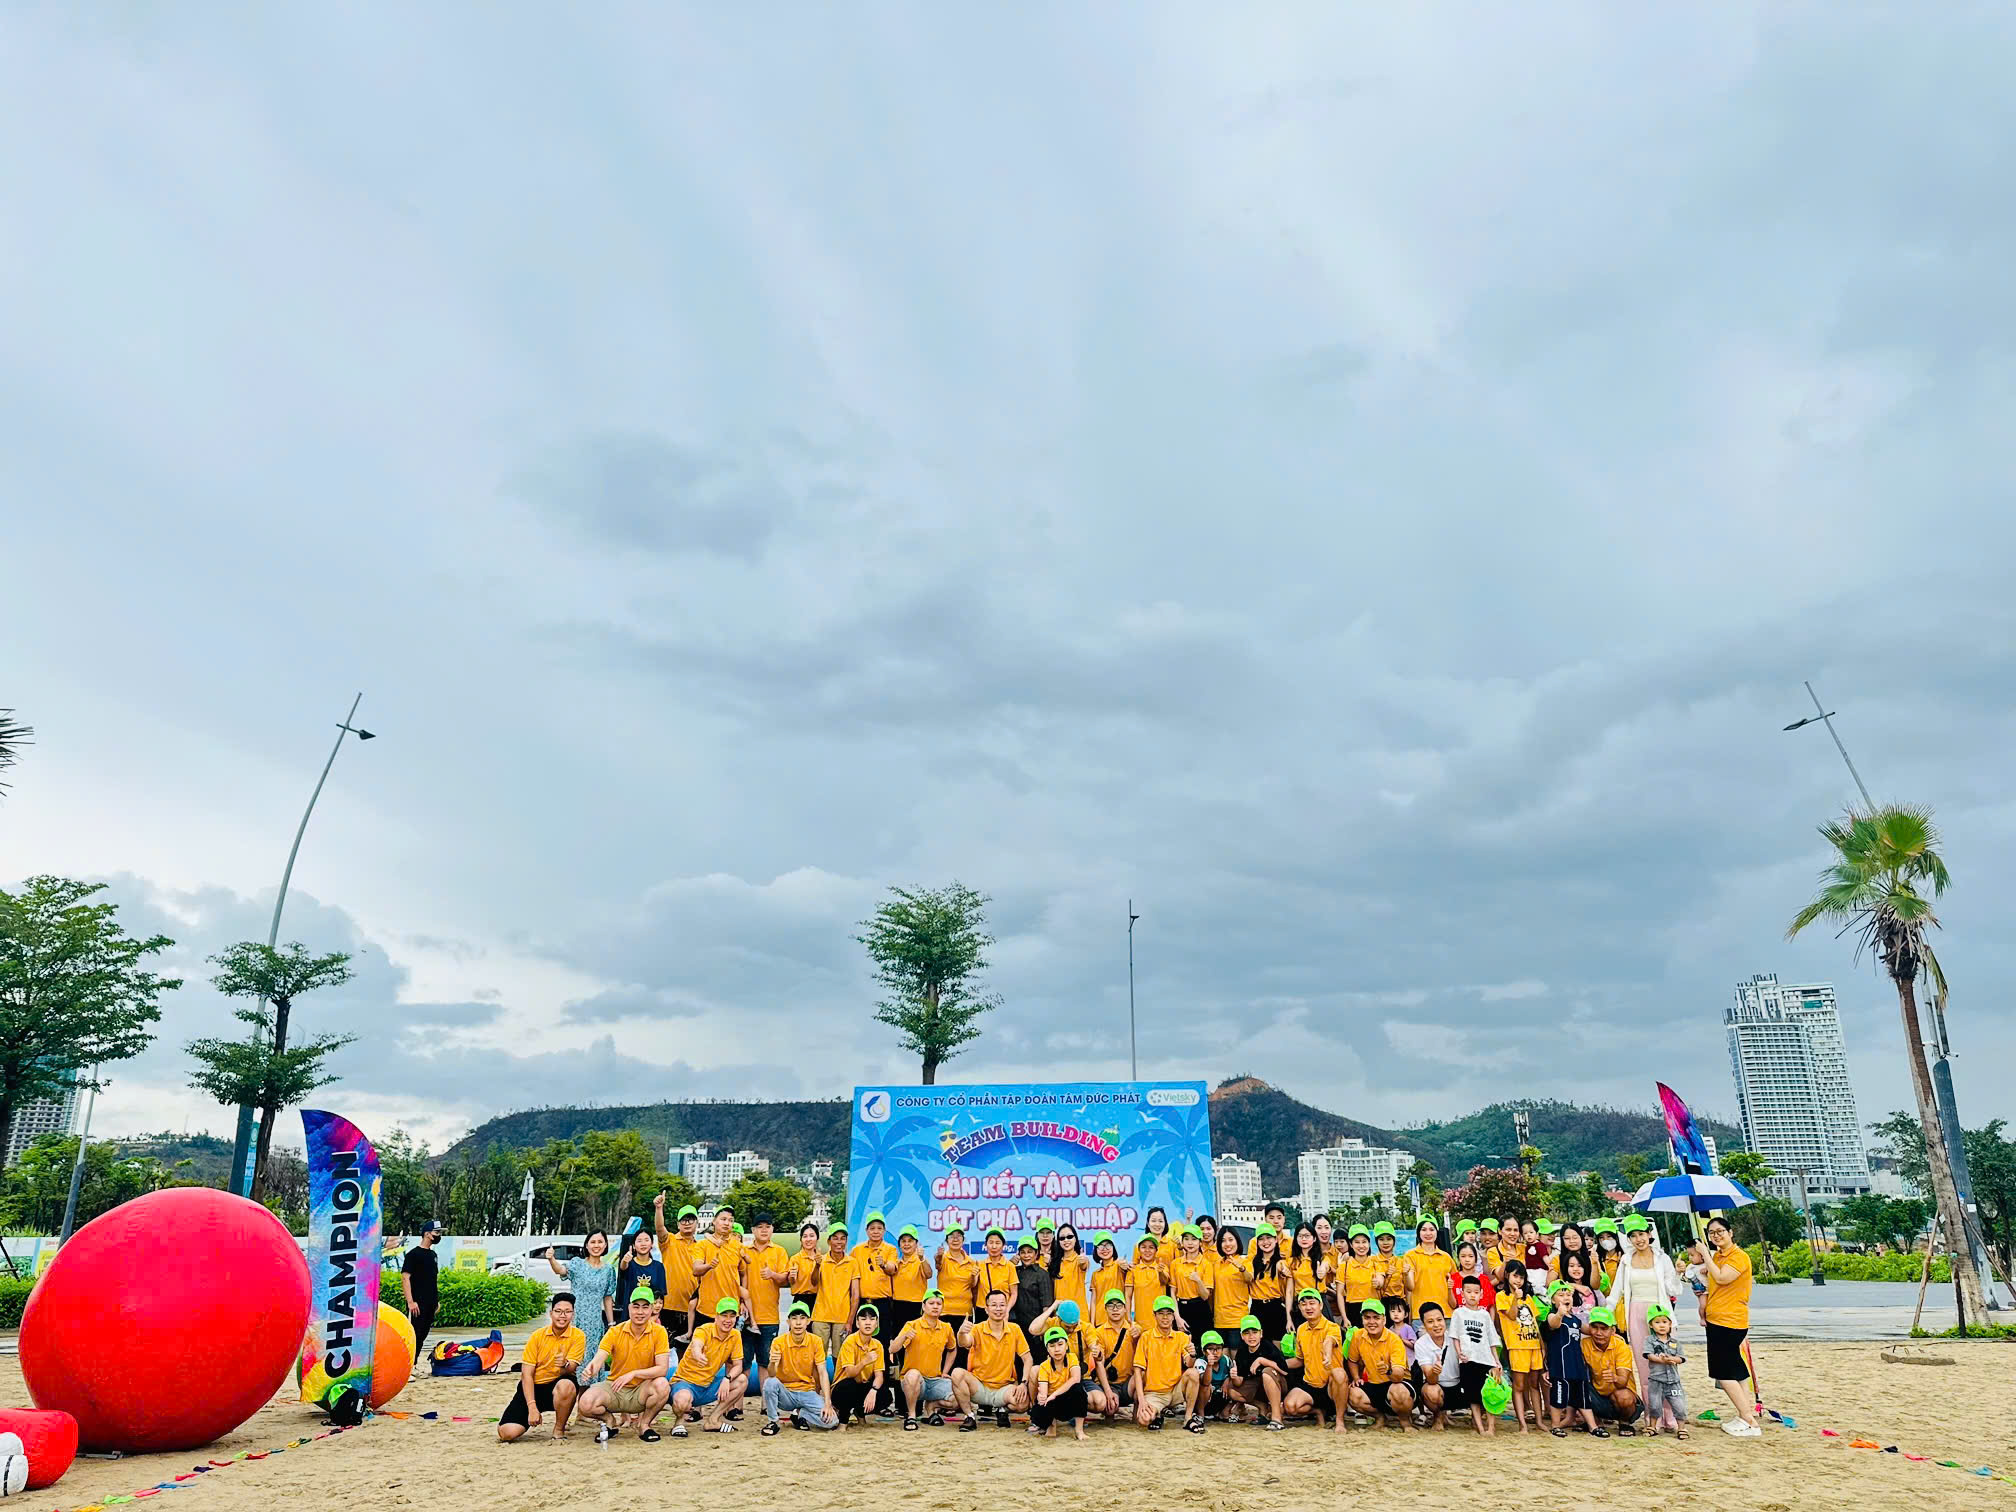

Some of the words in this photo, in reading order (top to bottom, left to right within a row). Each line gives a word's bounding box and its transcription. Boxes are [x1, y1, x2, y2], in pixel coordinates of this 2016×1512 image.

[896, 1095, 930, 1107] CÔNG
[933, 1097, 945, 1107] TY
[948, 1092, 965, 1106] CỔ
[969, 1092, 998, 1106] PHẦN
[1002, 1093, 1021, 1107] TẬP
[1025, 1092, 1057, 1105] ĐOÀN
[1060, 1093, 1082, 1105] TÂM
[1086, 1092, 1109, 1104] ĐỨC
[1112, 1092, 1140, 1104] PHÁT
[940, 1123, 1006, 1164] TEAM
[1010, 1121, 1121, 1162] BUILDING
[931, 1169, 979, 1199] GẮN
[982, 1168, 1028, 1198] KẾT
[1030, 1170, 1079, 1201] TẬN
[1082, 1169, 1134, 1197] TÂM
[928, 1204, 974, 1231] BỨT
[1075, 1202, 1138, 1233] NHẬP
[324, 1151, 361, 1378] CHAMPION
[1464, 1319, 1484, 1328] DEVELOP
